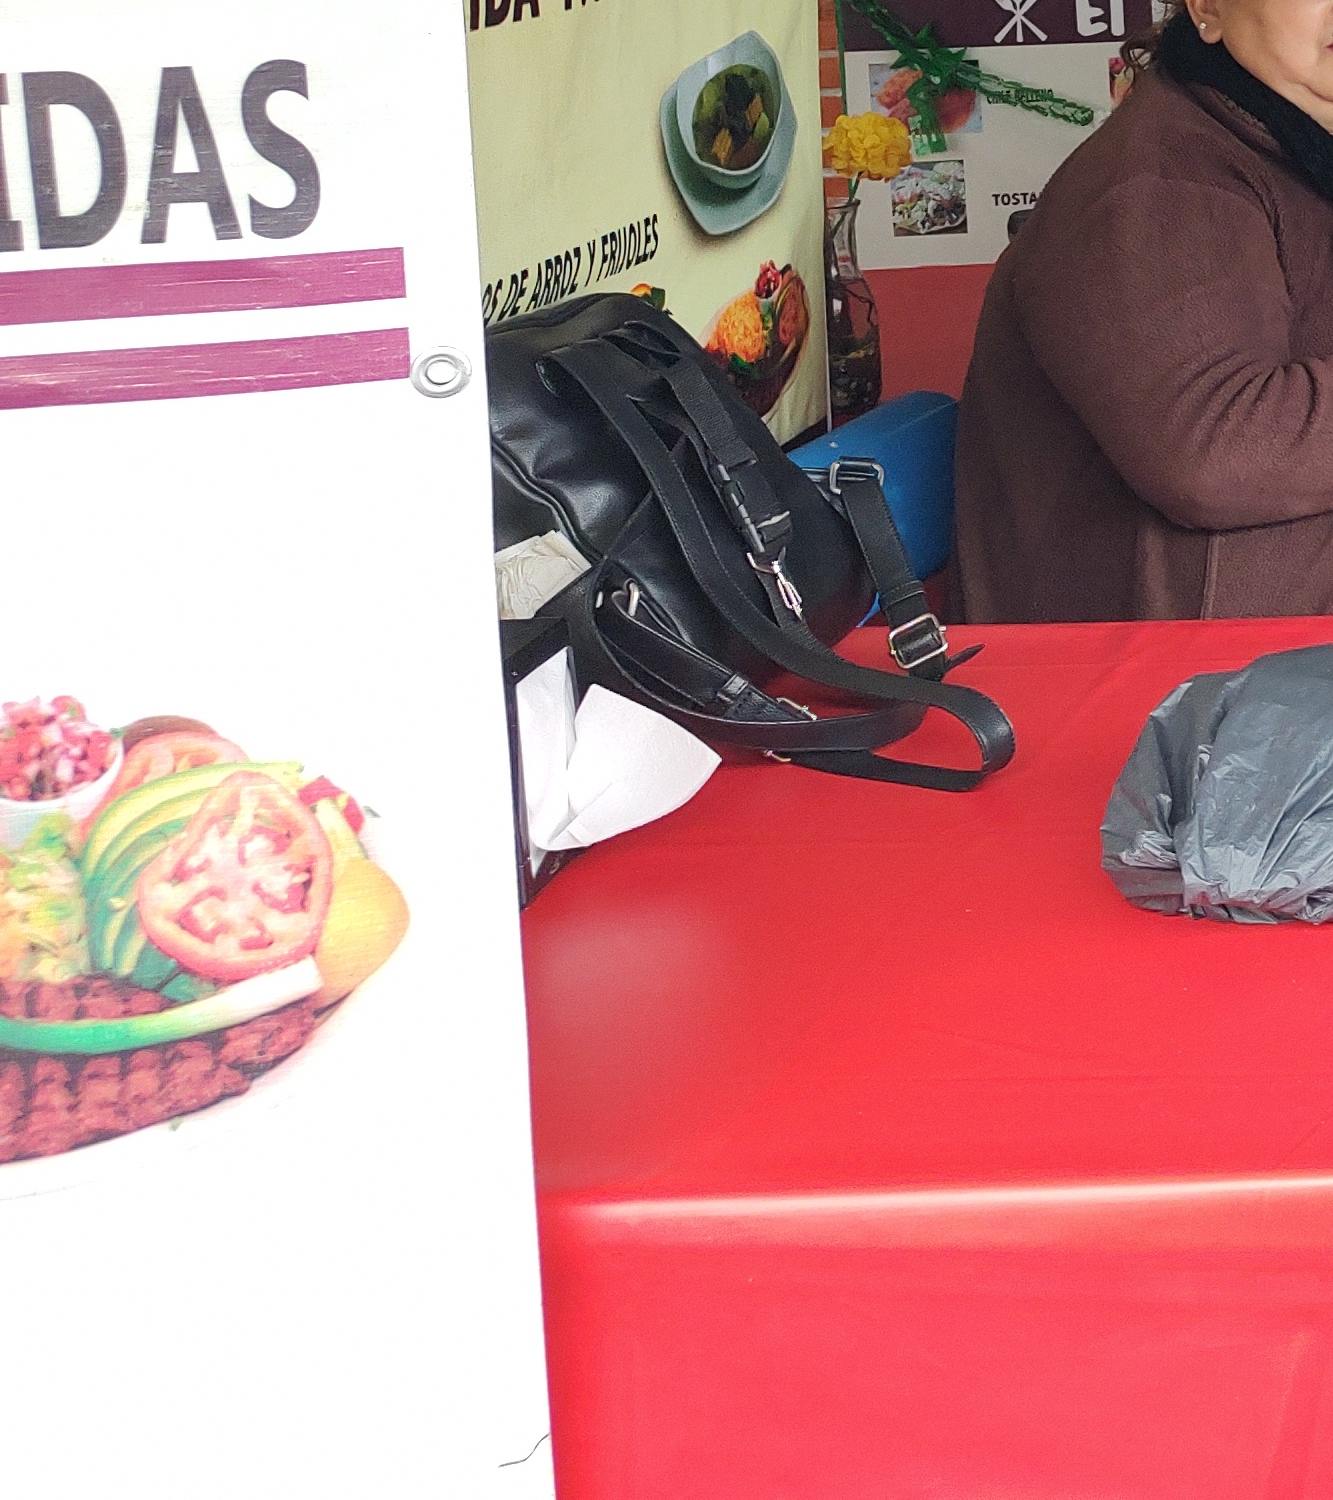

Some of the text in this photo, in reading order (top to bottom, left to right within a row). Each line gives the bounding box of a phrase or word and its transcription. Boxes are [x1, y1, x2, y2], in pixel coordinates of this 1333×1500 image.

[497, 214, 659, 322] DE ARROZ Y FRIJOLES
